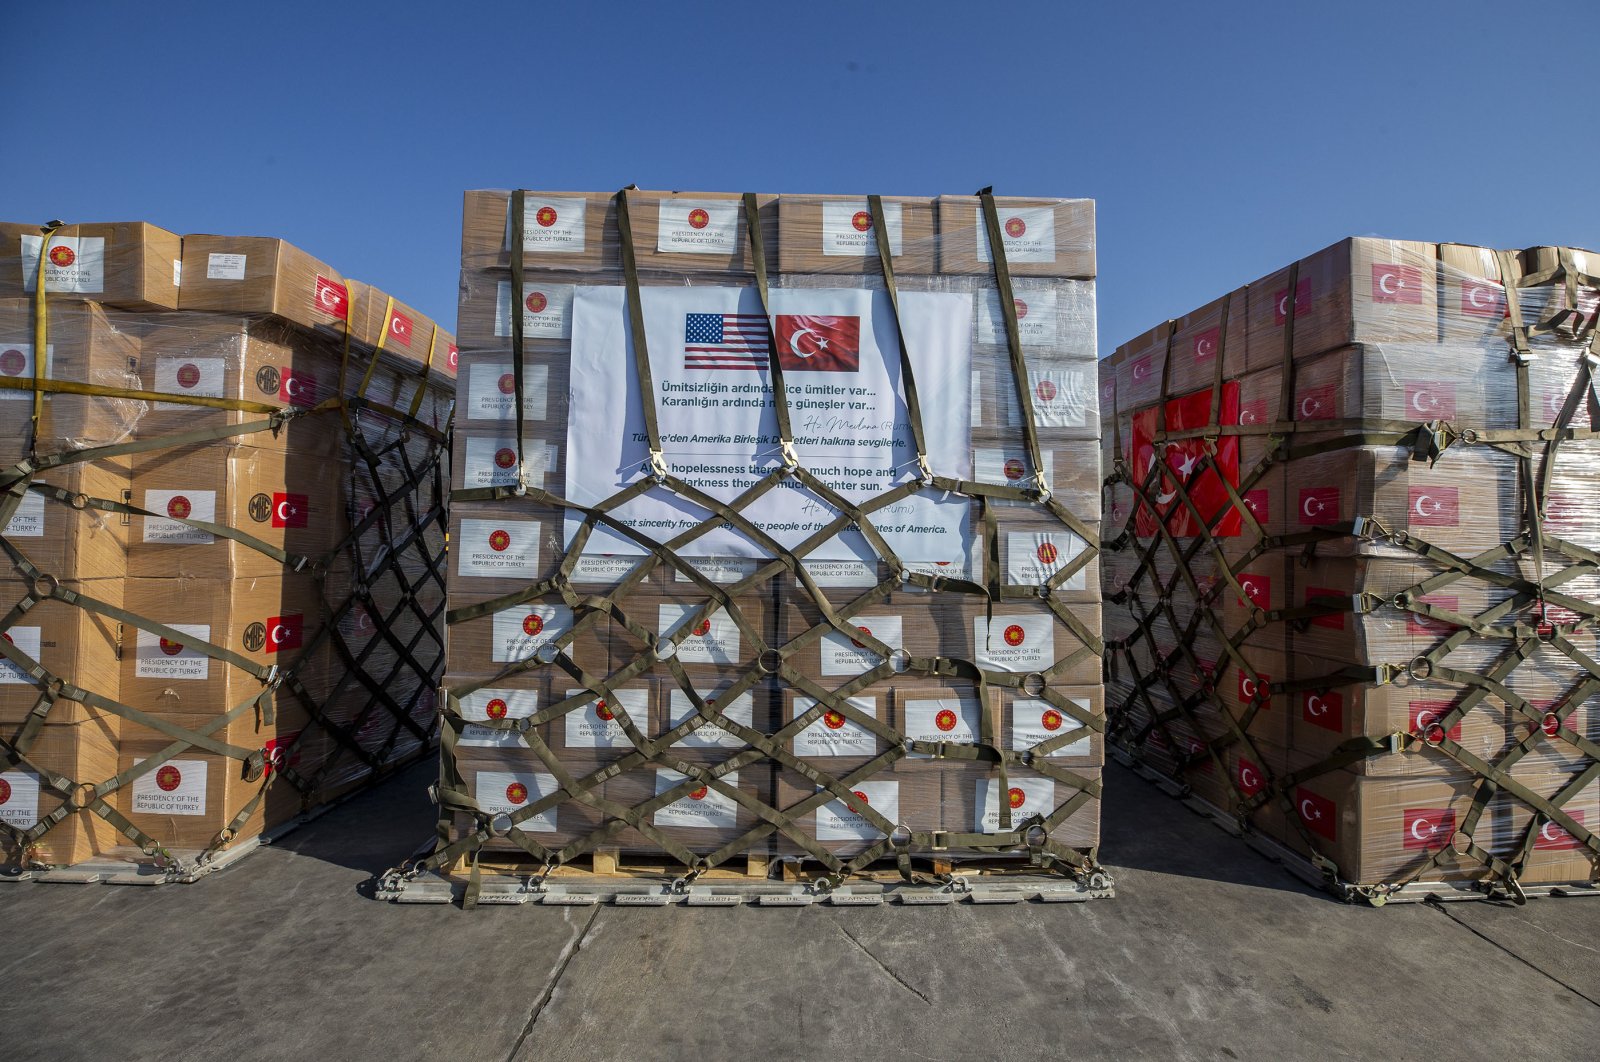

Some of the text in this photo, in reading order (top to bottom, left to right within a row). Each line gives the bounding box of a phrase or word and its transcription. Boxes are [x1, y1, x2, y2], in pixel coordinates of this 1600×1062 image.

[662, 380, 728, 394] Ümitsizliğin
[786, 384, 802, 394] ice
[805, 385, 846, 395] ümitler
[849, 387, 876, 396] var...
[662, 396, 876, 411] Karanlığın ardında ne güneşler var...
[690, 434, 731, 444] Amerika
[734, 435, 769, 445] Birleşik
[820, 436, 856, 446] halkına
[858, 438, 907, 449] sevgilerle.
[671, 463, 745, 475] hopelessness
[748, 464, 778, 475] there
[810, 466, 841, 476] much
[844, 467, 872, 478] hope
[875, 467, 897, 477] and
[823, 480, 858, 491] ighter
[860, 482, 883, 491] sun.
[879, 504, 915, 516] (Rumi)
[638, 518, 676, 529] sincerity
[766, 522, 799, 532] people
[801, 522, 812, 531] of
[875, 524, 892, 532] ates
[907, 525, 947, 534] America.
